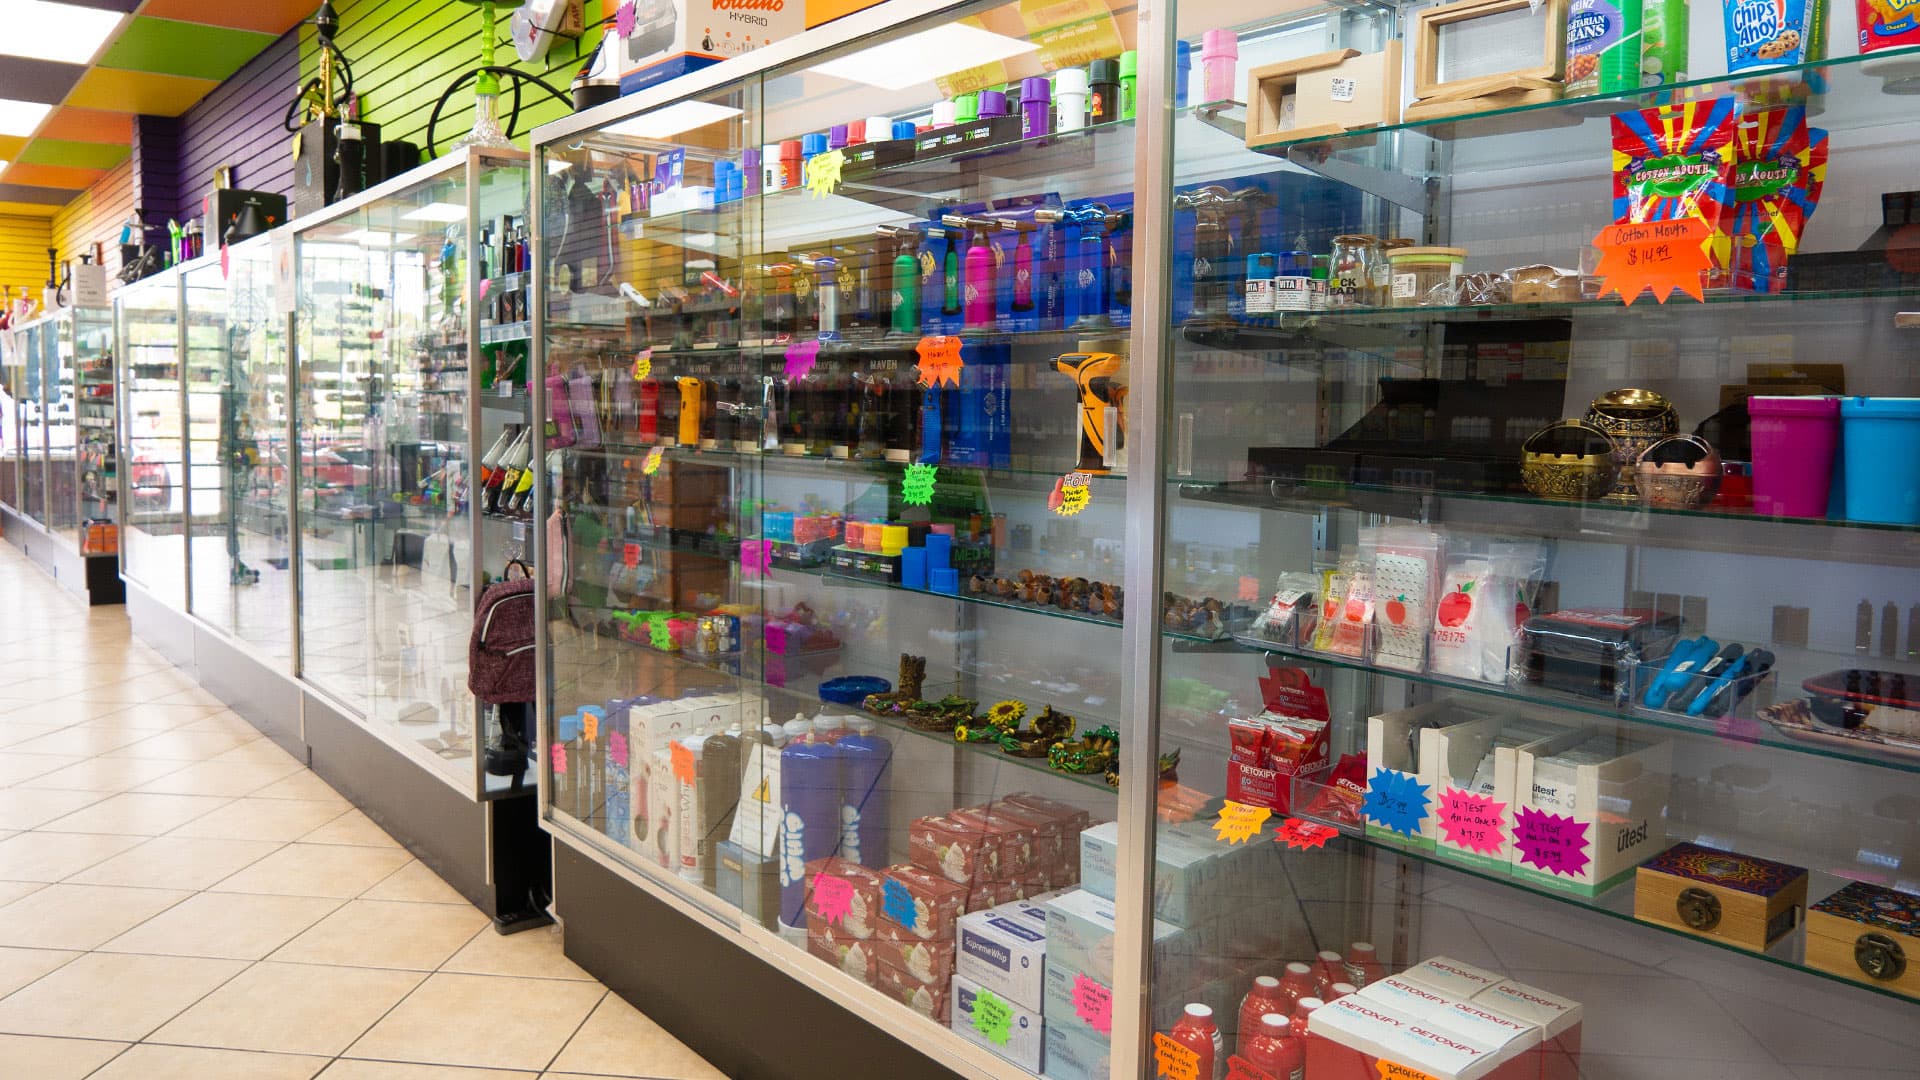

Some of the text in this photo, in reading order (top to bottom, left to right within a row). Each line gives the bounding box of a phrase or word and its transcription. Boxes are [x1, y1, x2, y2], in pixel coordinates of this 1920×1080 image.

[729, 12, 768, 27] HYBRID
[1733, 1, 1775, 32] Chips
[1616, 223, 1688, 246] Cotton Mouth
[1280, 281, 1294, 290] VITA
[1064, 473, 1093, 488] HOT!
[1240, 764, 1277, 780] DETOXIFY
[1532, 784, 1557, 796] ütest
[1567, 793, 1577, 809] 3
[1617, 819, 1648, 852] ütest
[965, 936, 1007, 963] SupremeWhip
[1429, 961, 1492, 984] DETOXIFY
[1386, 979, 1450, 1004] DETOXIFY
[1499, 985, 1568, 1011] DETOXIFY
[1338, 1000, 1405, 1028] DETOXIFY
[1456, 1003, 1525, 1030] DETOXIFY
[1410, 1026, 1482, 1055] DETOXIFY
